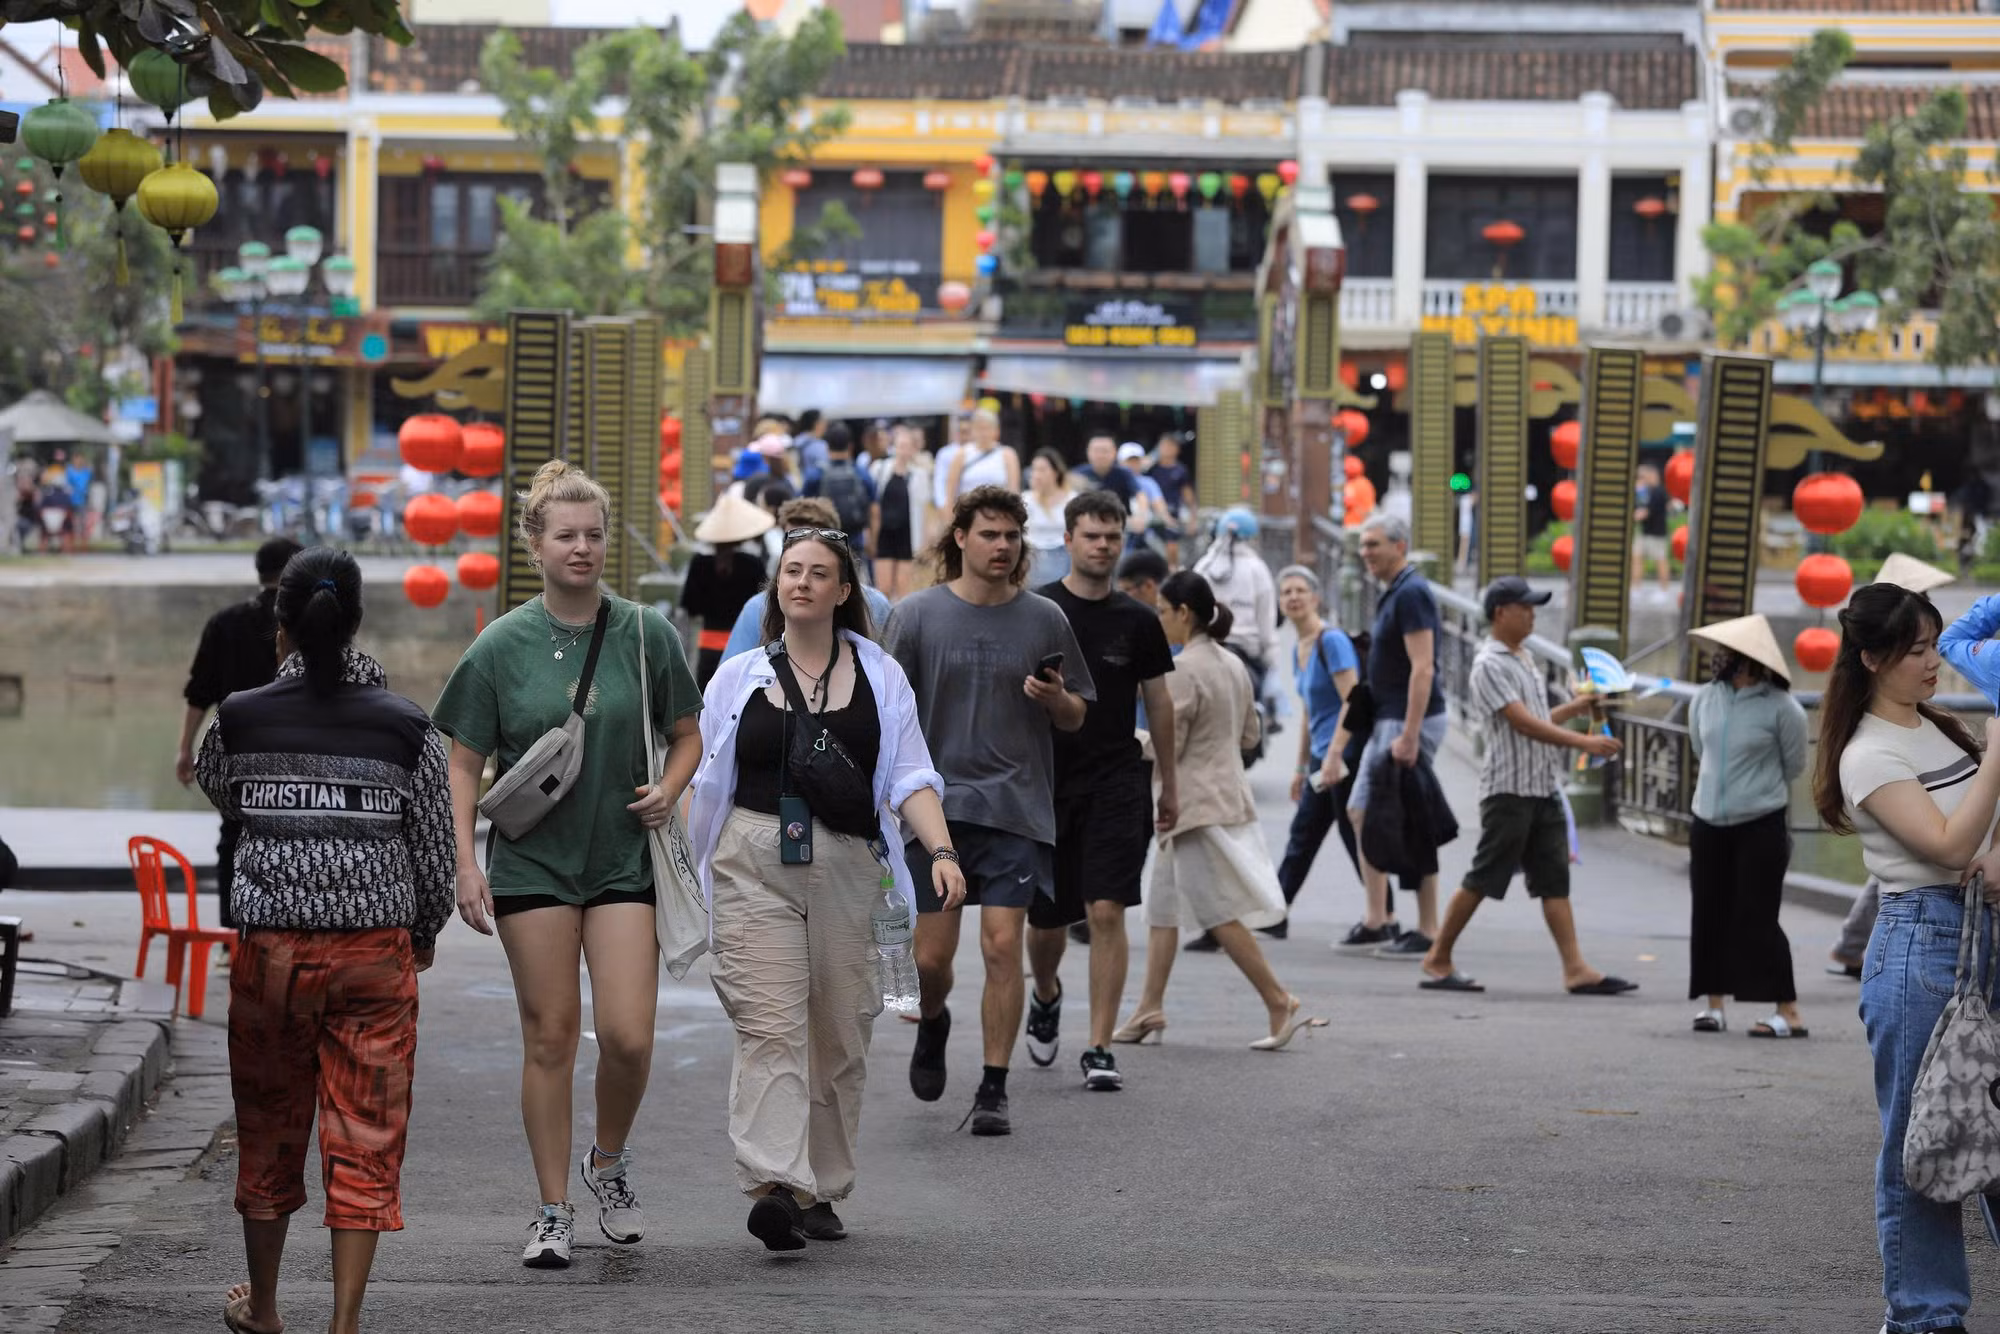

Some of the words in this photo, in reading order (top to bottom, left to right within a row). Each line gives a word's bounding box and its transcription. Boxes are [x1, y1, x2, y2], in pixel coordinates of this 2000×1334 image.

[1462, 283, 1537, 316] SPA
[240, 781, 347, 809] CHRISTIAN
[360, 788, 402, 813] DIOR
